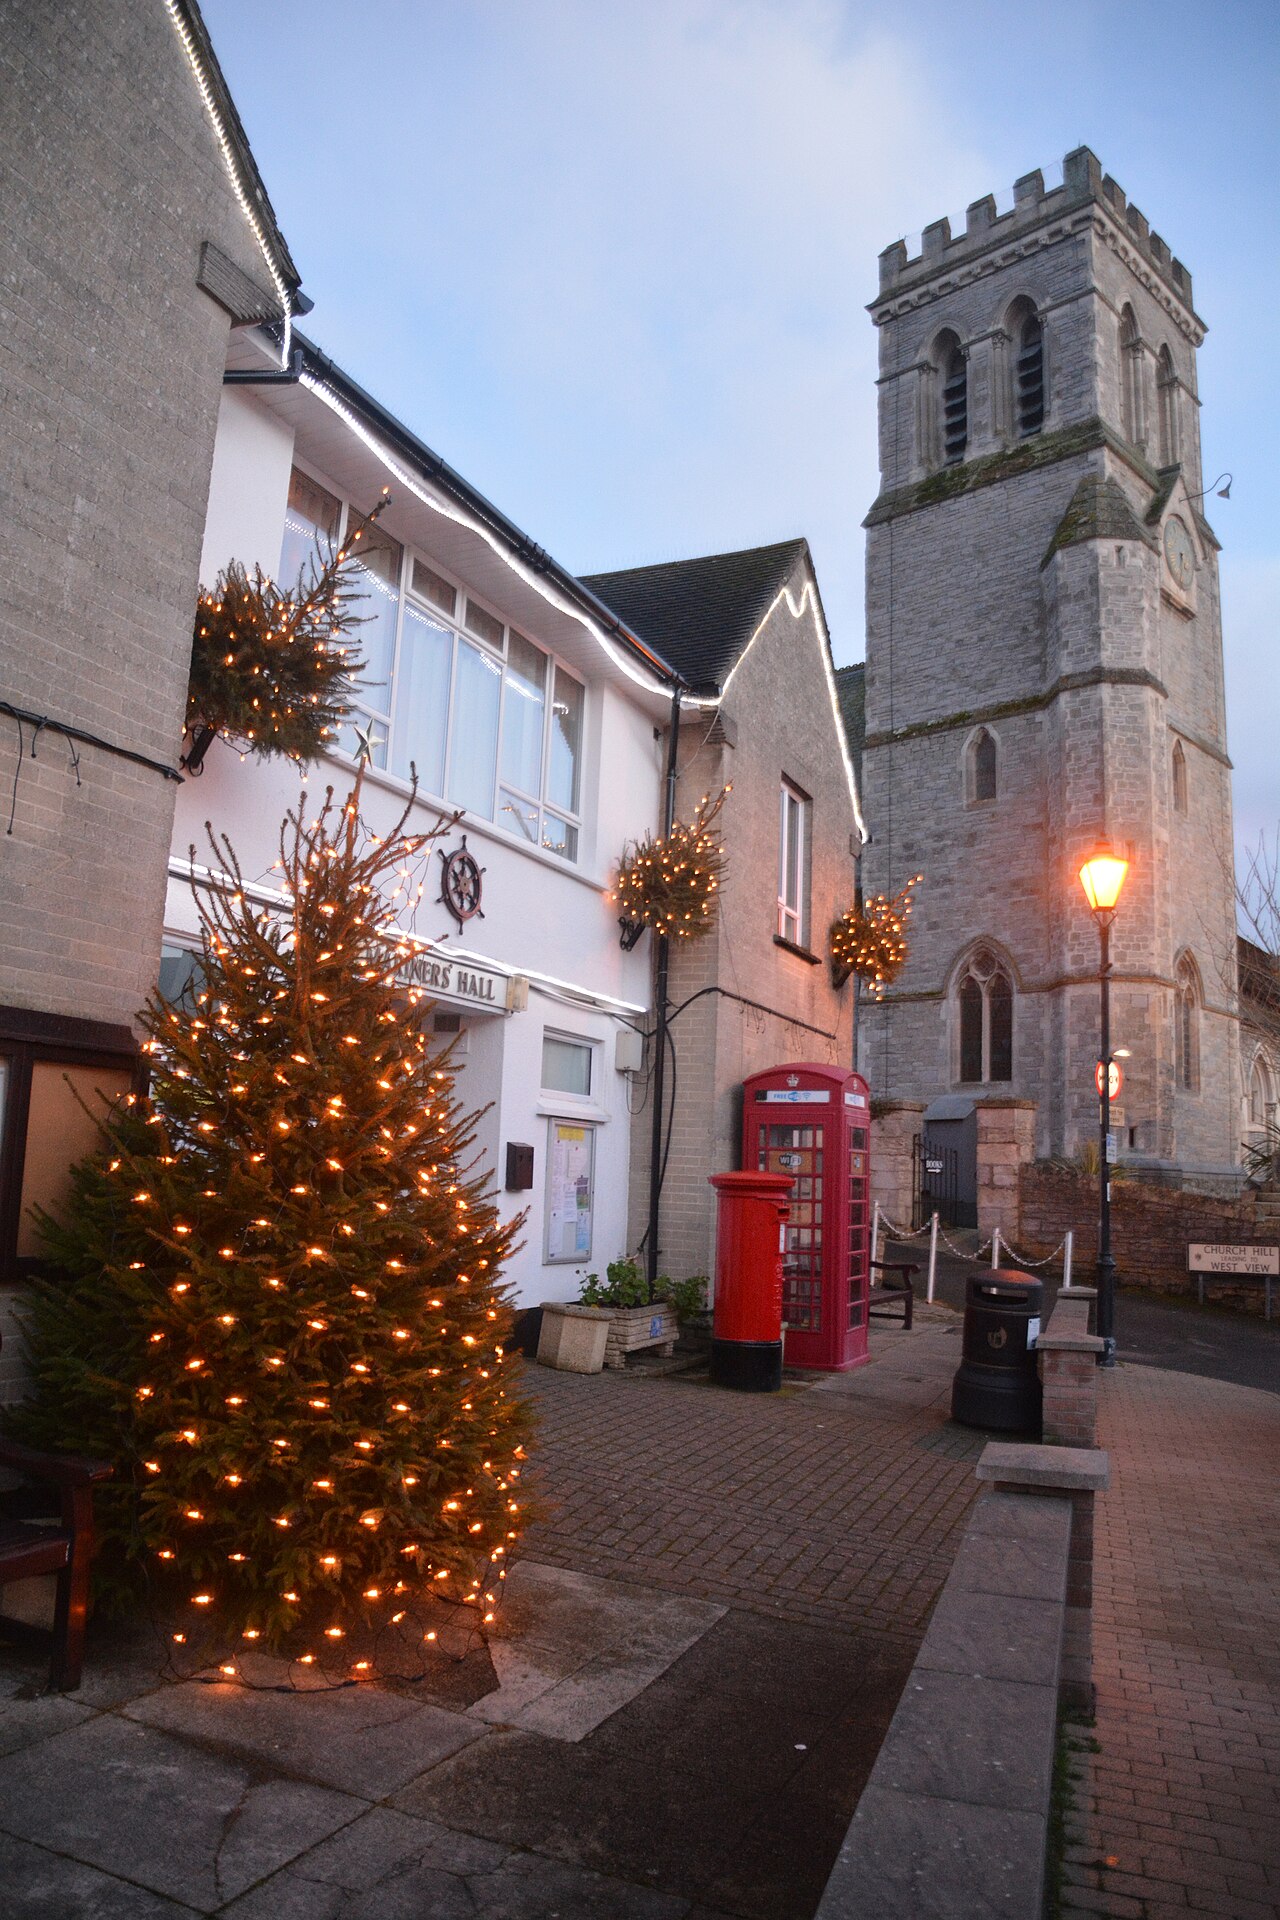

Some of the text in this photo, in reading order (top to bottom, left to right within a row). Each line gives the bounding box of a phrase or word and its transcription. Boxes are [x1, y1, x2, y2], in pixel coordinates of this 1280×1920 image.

[457, 970, 496, 1000] HALL
[1204, 1245, 1275, 1256] CHURCH HILL
[1210, 1262, 1270, 1272] WEST VIEW
